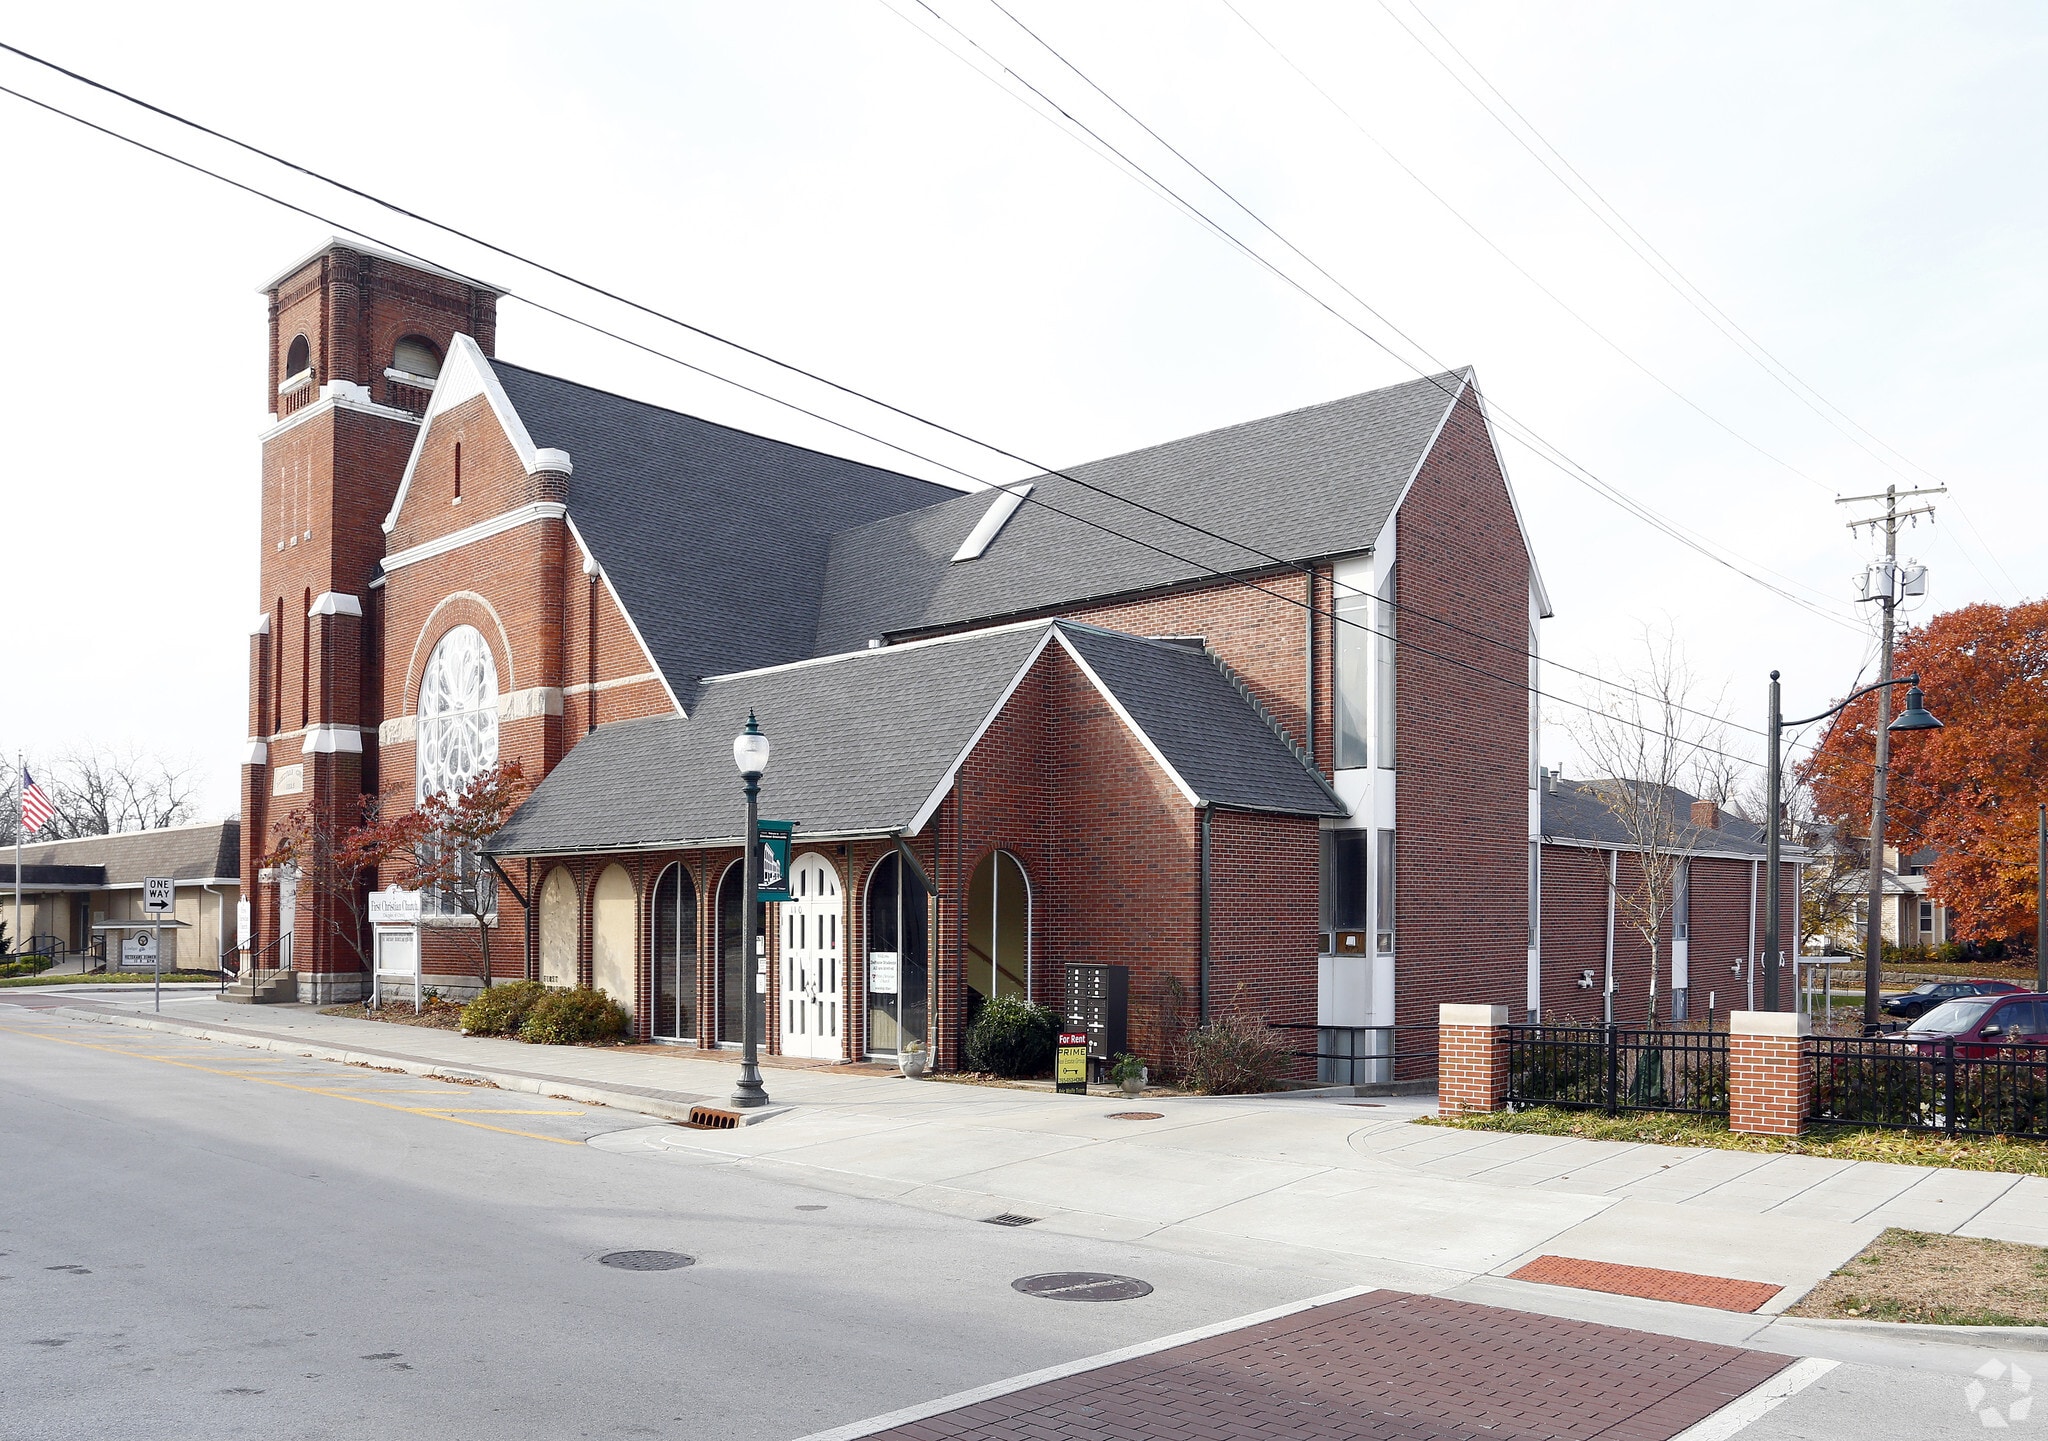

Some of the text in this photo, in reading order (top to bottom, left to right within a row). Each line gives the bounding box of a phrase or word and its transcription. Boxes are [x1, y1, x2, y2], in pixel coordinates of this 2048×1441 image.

[150, 880, 169, 889] ONE
[149, 890, 170, 898] WAY
[371, 900, 419, 912] First Christian Church
[790, 905, 803, 914] 110
[1060, 1034, 1086, 1044] For Rent
[1058, 1048, 1086, 1056] PRIME
